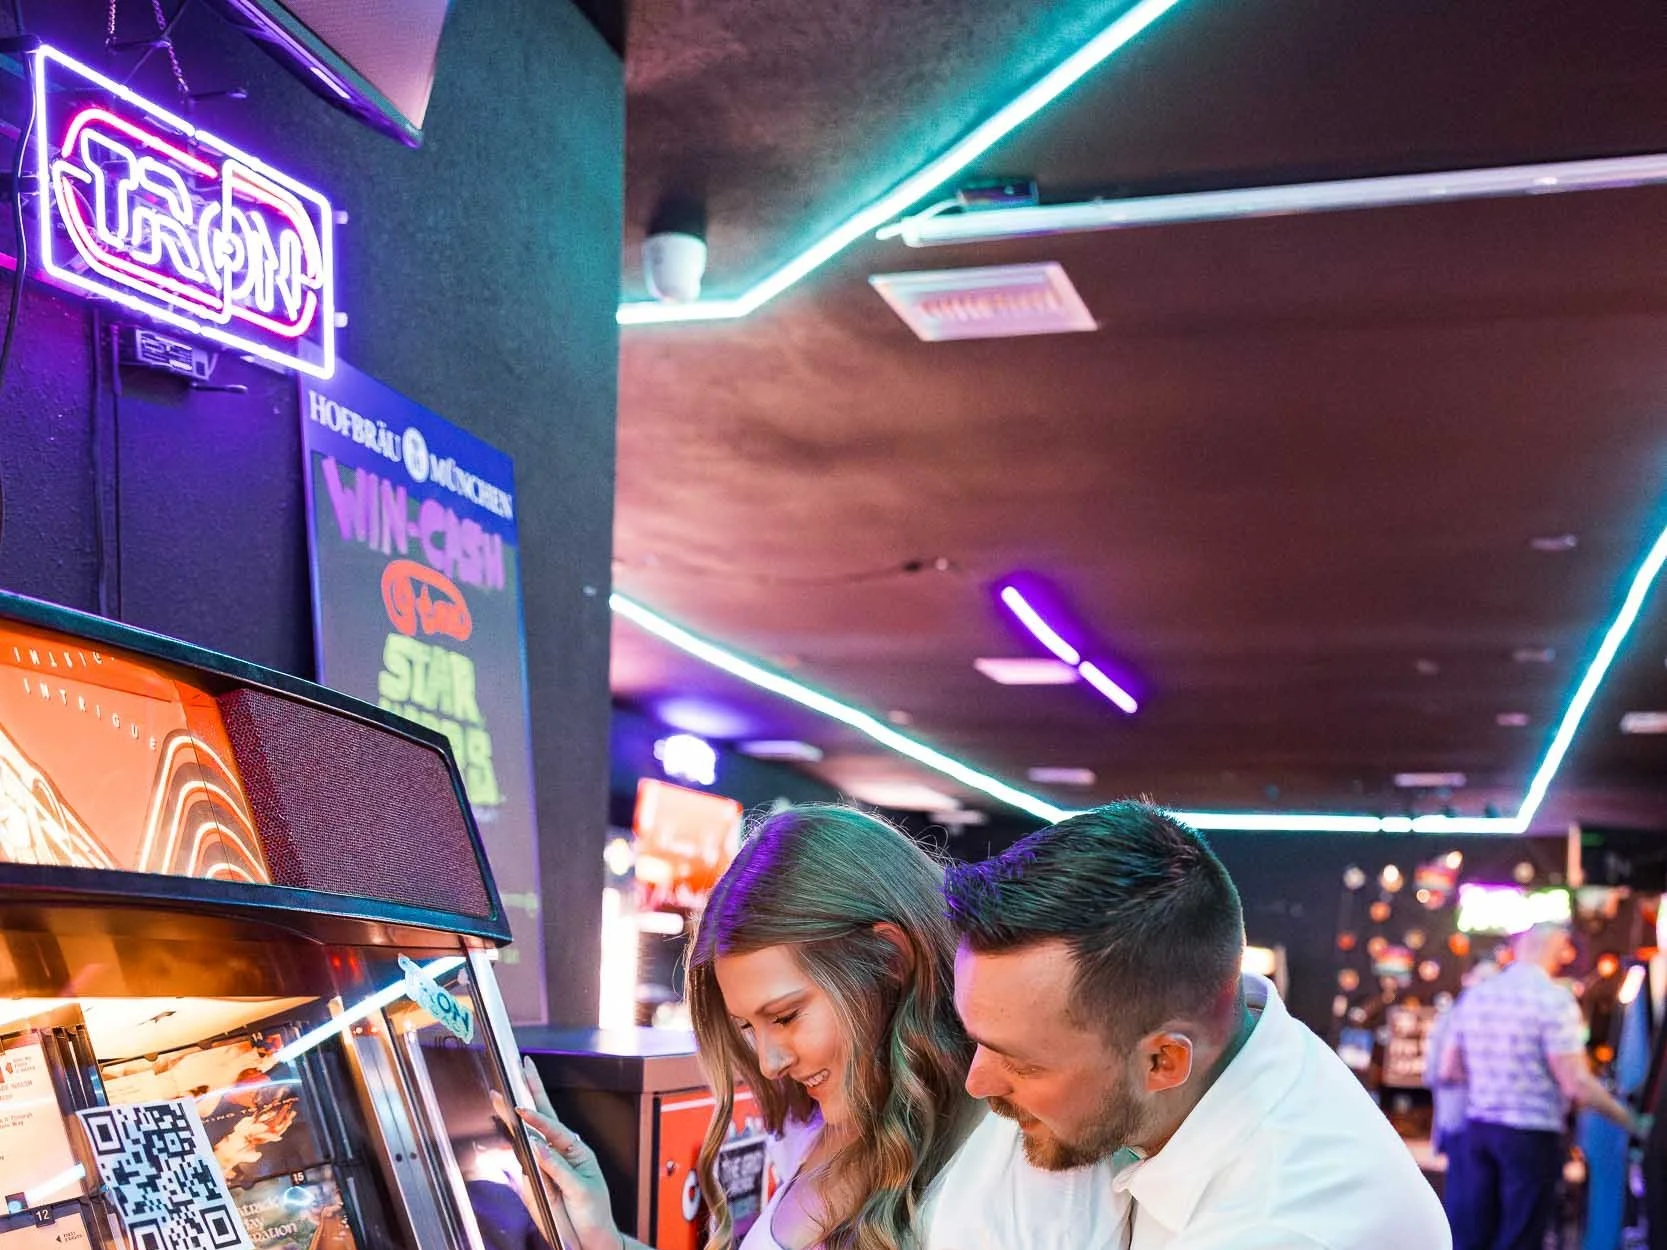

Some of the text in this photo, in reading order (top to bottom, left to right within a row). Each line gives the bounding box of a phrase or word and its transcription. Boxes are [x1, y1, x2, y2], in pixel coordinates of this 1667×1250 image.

[80, 127, 305, 322] TRON
[308, 389, 401, 462] HOFBRÄU
[429, 453, 513, 520] MÜNCHEN
[23, 677, 157, 751] INTRIGUE
[378, 632, 482, 723] STAR
[36, 1209, 50, 1222] 12
[293, 1172, 305, 1183] 15
